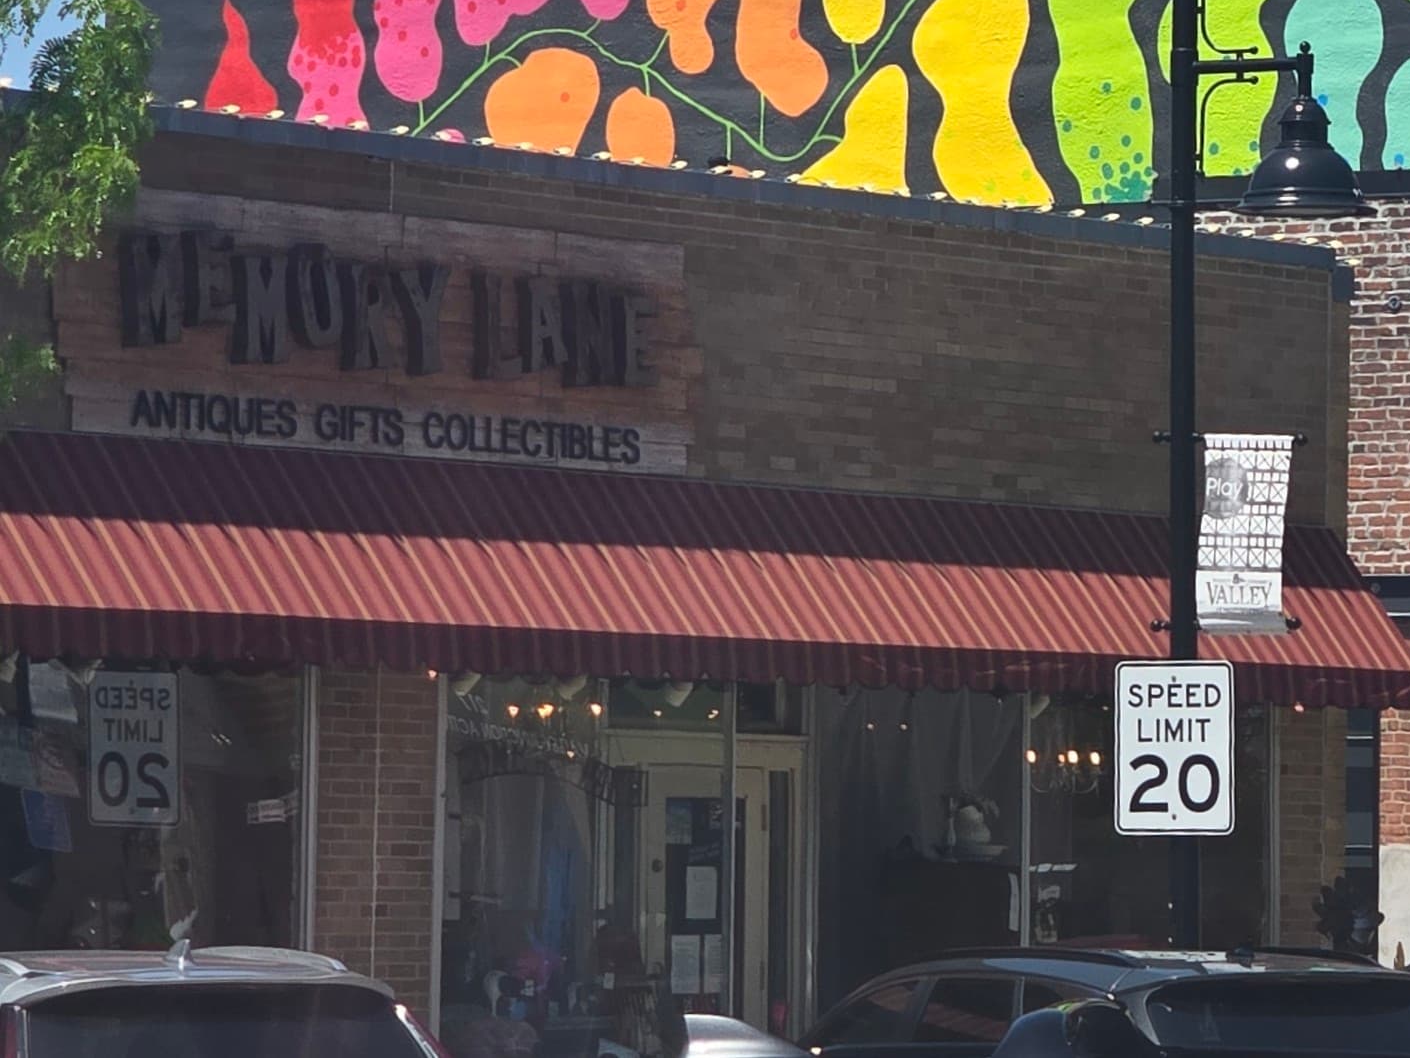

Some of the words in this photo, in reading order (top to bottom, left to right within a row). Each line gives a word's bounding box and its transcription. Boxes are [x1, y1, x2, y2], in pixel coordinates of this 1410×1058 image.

[118, 229, 450, 376] MEMORY
[470, 265, 659, 388] LANE
[130, 389, 298, 439] ANTIQUES
[314, 403, 405, 448] GIFTS
[422, 411, 641, 465] COLLECTIBLES
[1205, 478, 1244, 499] Play
[1206, 581, 1273, 607] VALLEY
[1128, 683, 1222, 708] SPEED
[1137, 718, 1211, 742] LIMIT
[1129, 754, 1221, 813] 20
